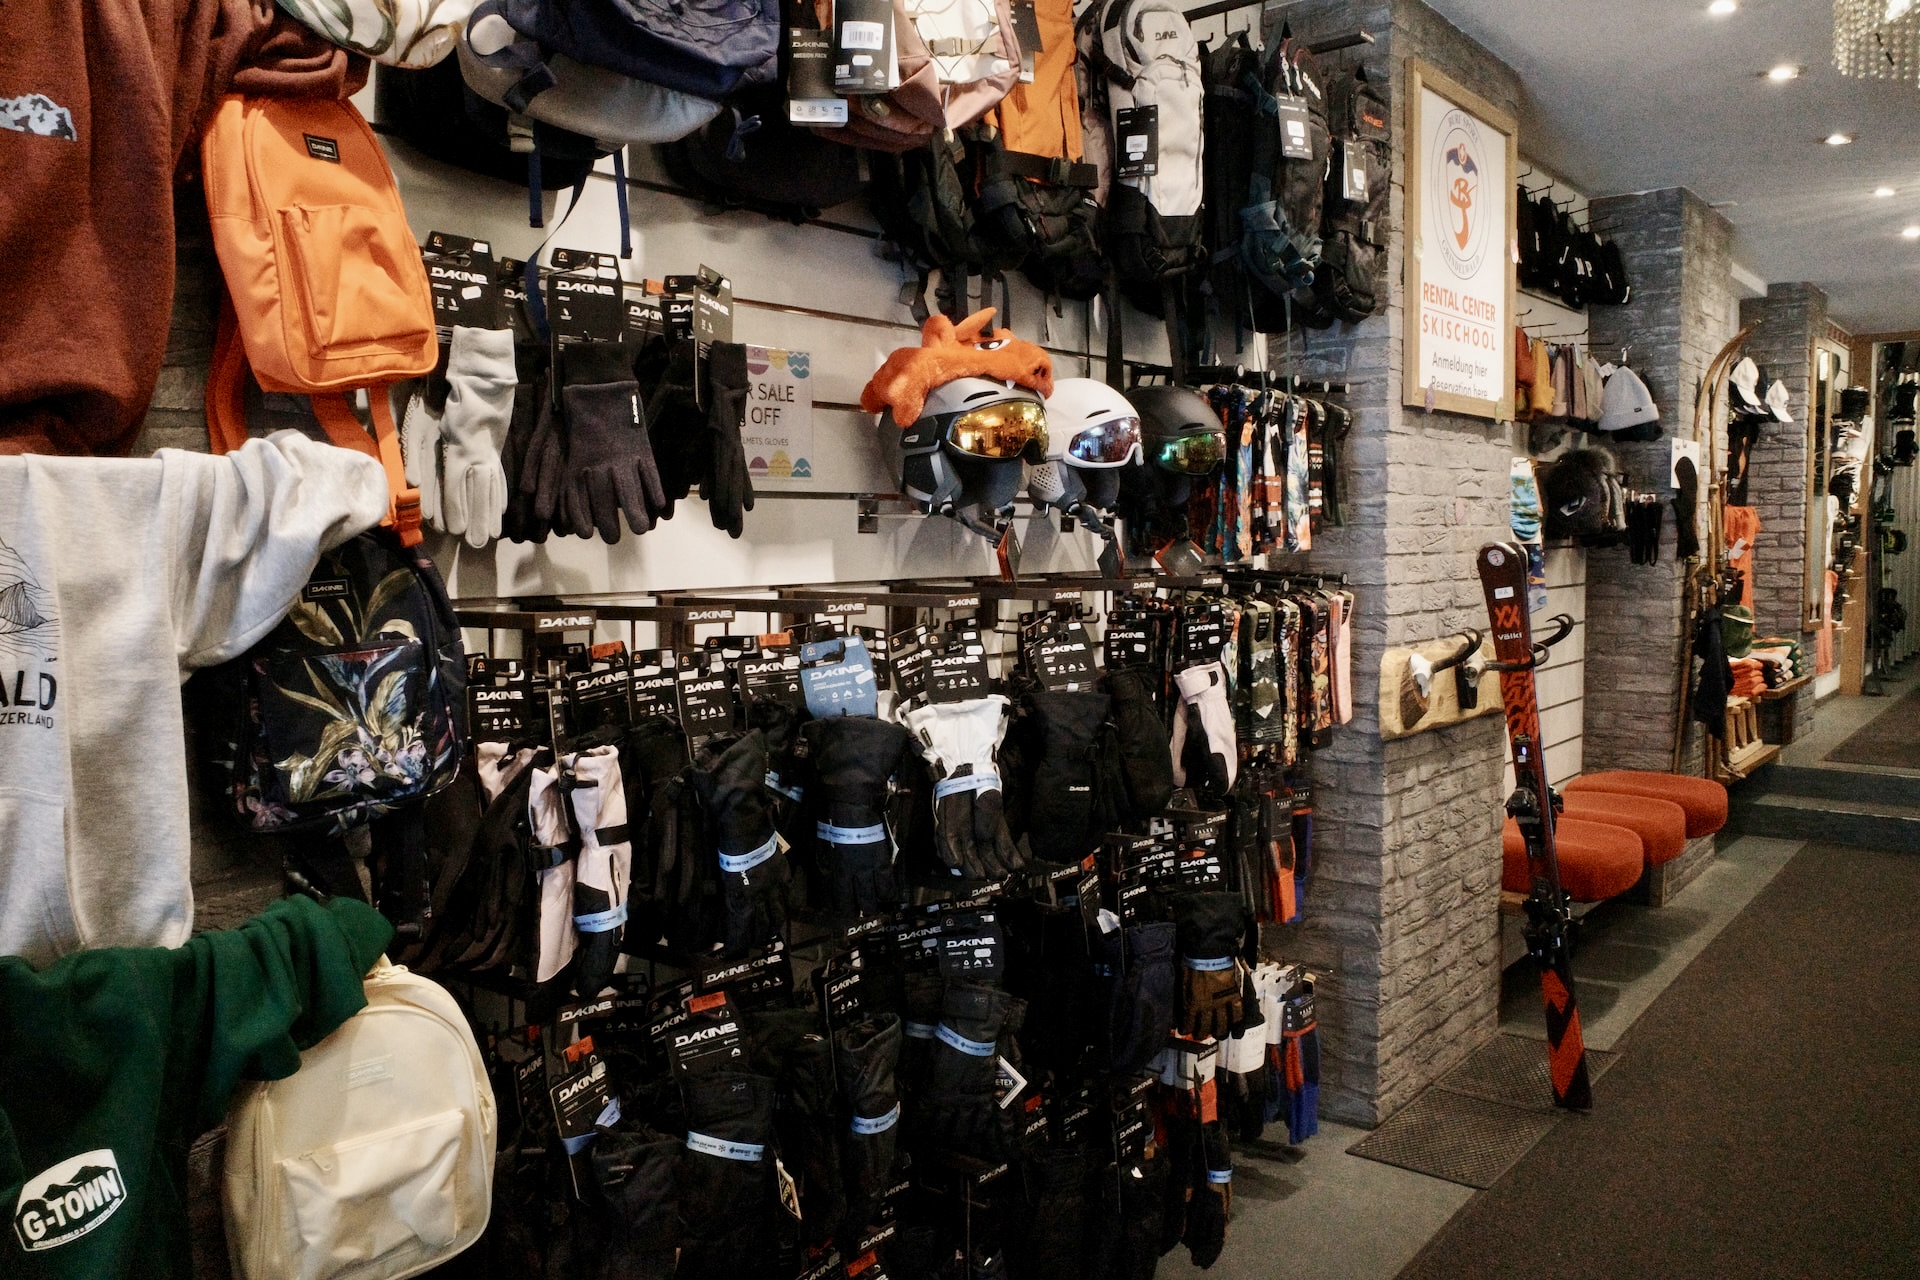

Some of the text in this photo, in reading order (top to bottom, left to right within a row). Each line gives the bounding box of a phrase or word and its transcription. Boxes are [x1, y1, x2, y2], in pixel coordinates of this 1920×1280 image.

[310, 142, 334, 156] DAKINE
[430, 267, 489, 285] DAKINE
[556, 280, 616, 296] DAKINE
[699, 294, 730, 316] DAKINE
[1423, 281, 1496, 322] RENTAL CENTER
[629, 305, 663, 320] DAKIN
[1423, 313, 1496, 352] SKISCHOOL
[1432, 351, 1488, 379] Anmeldung hier
[758, 383, 795, 403] SALE
[632, 394, 640, 425] DAKINE
[751, 406, 781, 426] OFF
[765, 437, 789, 447] GLOVES
[311, 584, 345, 593] DAKINE
[1134, 582, 1156, 590] DAKINE
[948, 598, 979, 608] DAKINE
[1055, 591, 1081, 600] DAKINE
[688, 610, 734, 621] DAKINE
[827, 602, 865, 613] DAKINE
[539, 616, 594, 629] DAKINE
[1188, 623, 1220, 633] DAKINE
[1110, 631, 1146, 640] DAKINE
[1041, 643, 1087, 655] DAKINE
[896, 649, 933, 669] DAKINE
[931, 655, 981, 668] DAKINE
[810, 664, 865, 681] DAKINE
[576, 671, 629, 692] DAKINE
[634, 677, 675, 691] DAKINE
[684, 680, 726, 694] DAKINE
[476, 690, 525, 701] DAKINE
[1206, 814, 1227, 824] DAKINE
[1132, 838, 1155, 849] DAKINE
[1141, 851, 1176, 863] DAKINE
[1180, 857, 1219, 869] DAKINE
[1051, 865, 1079, 879] DAKINE
[972, 883, 1000, 897] DAKINE
[1081, 874, 1099, 894] DAKINE
[1123, 885, 1147, 899] DAKINE
[898, 925, 942, 942] DAKINE
[946, 936, 996, 948] DAKINE
[706, 963, 751, 984] DAKINE
[831, 975, 860, 995] DAKINE
[560, 1000, 613, 1022] DAKINE
[674, 1021, 739, 1048] DAKINE
[519, 1055, 544, 1081] DAKINE
[559, 1068, 606, 1103] DAKINE
[1131, 1078, 1154, 1095] DAKINE
[1064, 1107, 1089, 1125] DAKINE
[1119, 1121, 1143, 1140] DAKINE
[979, 1163, 1009, 1183] DAKINE
[22, 1168, 121, 1241] G-TOWN
[33, 1228, 80, 1249] GRINDELWALD
[860, 1226, 895, 1250] DAKINE
